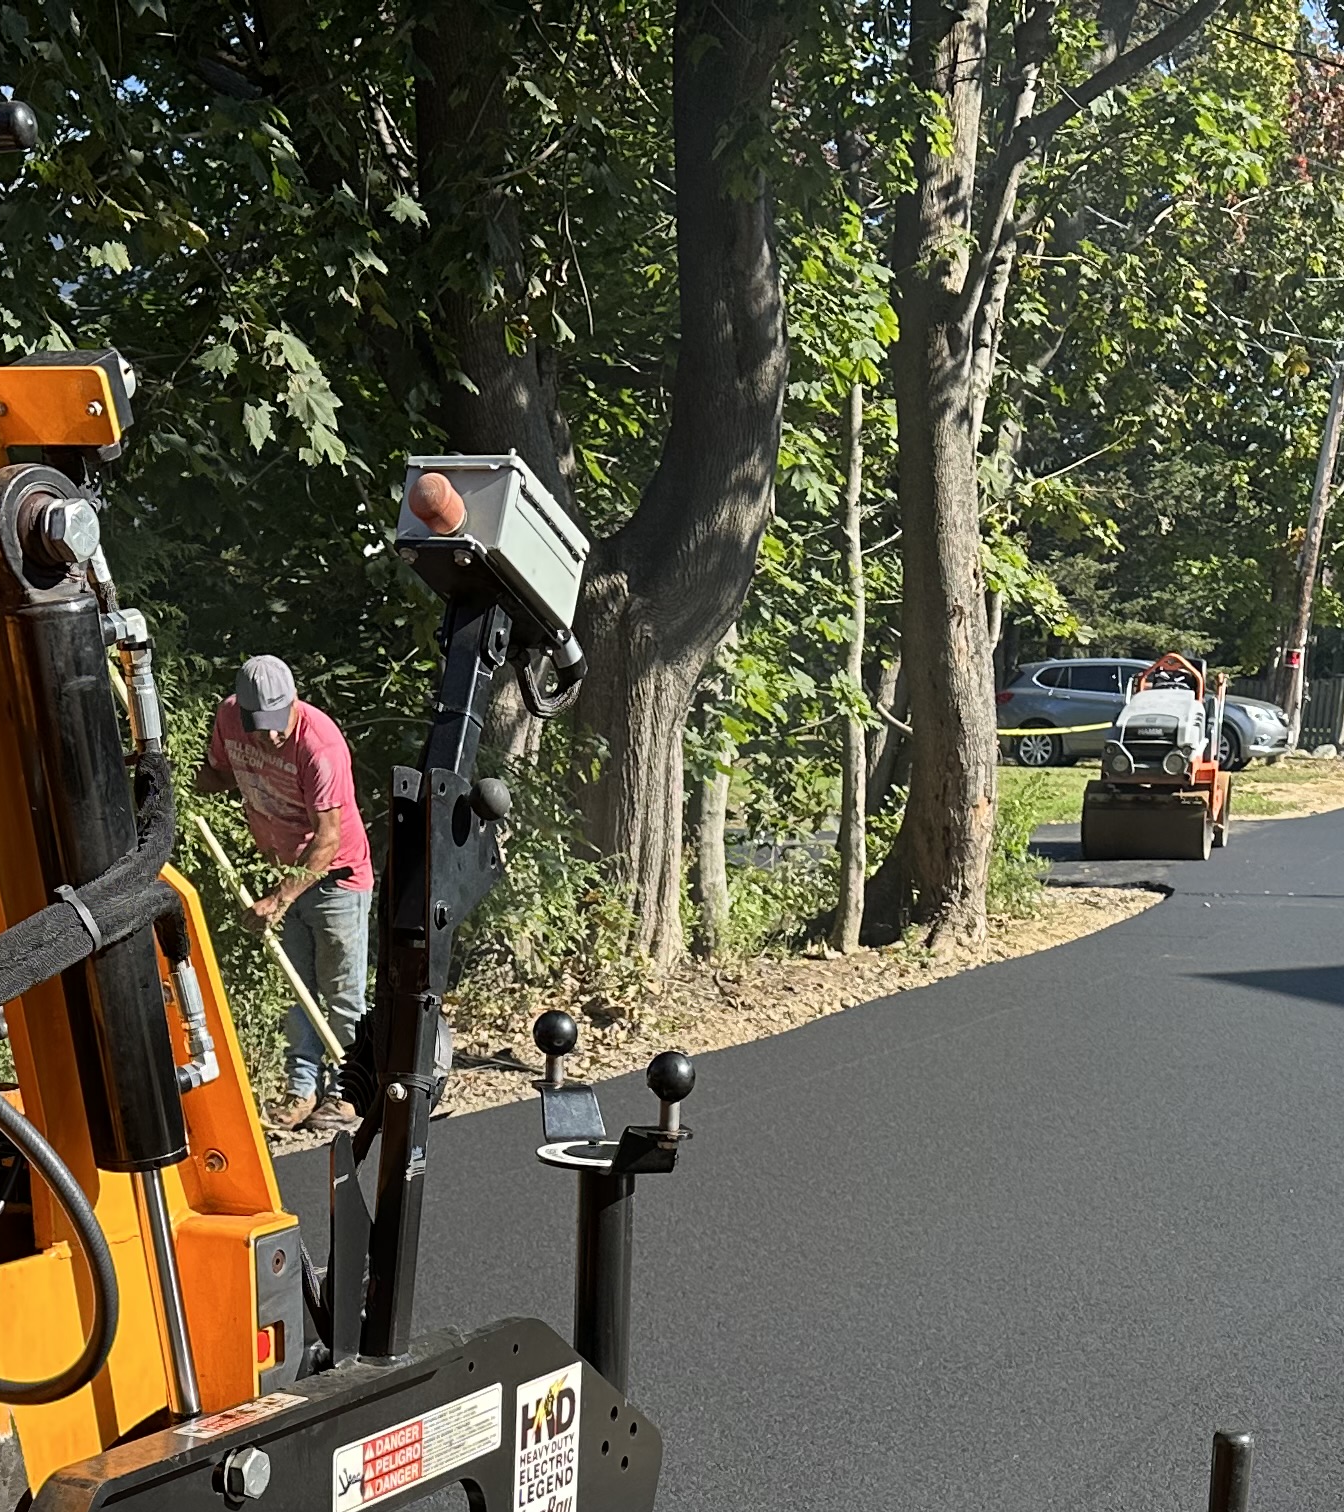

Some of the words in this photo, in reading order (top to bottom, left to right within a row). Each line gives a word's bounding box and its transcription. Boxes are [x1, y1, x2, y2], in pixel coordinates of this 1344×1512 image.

[376, 1424, 420, 1455] DANGER
[519, 1445, 549, 1469] HEAVY
[550, 1432, 575, 1455] DUTY
[375, 1443, 421, 1473] PELIGRO
[519, 1448, 574, 1487] ELECTRIC
[374, 1463, 419, 1494] DANGER
[518, 1466, 573, 1508] LEGEND
